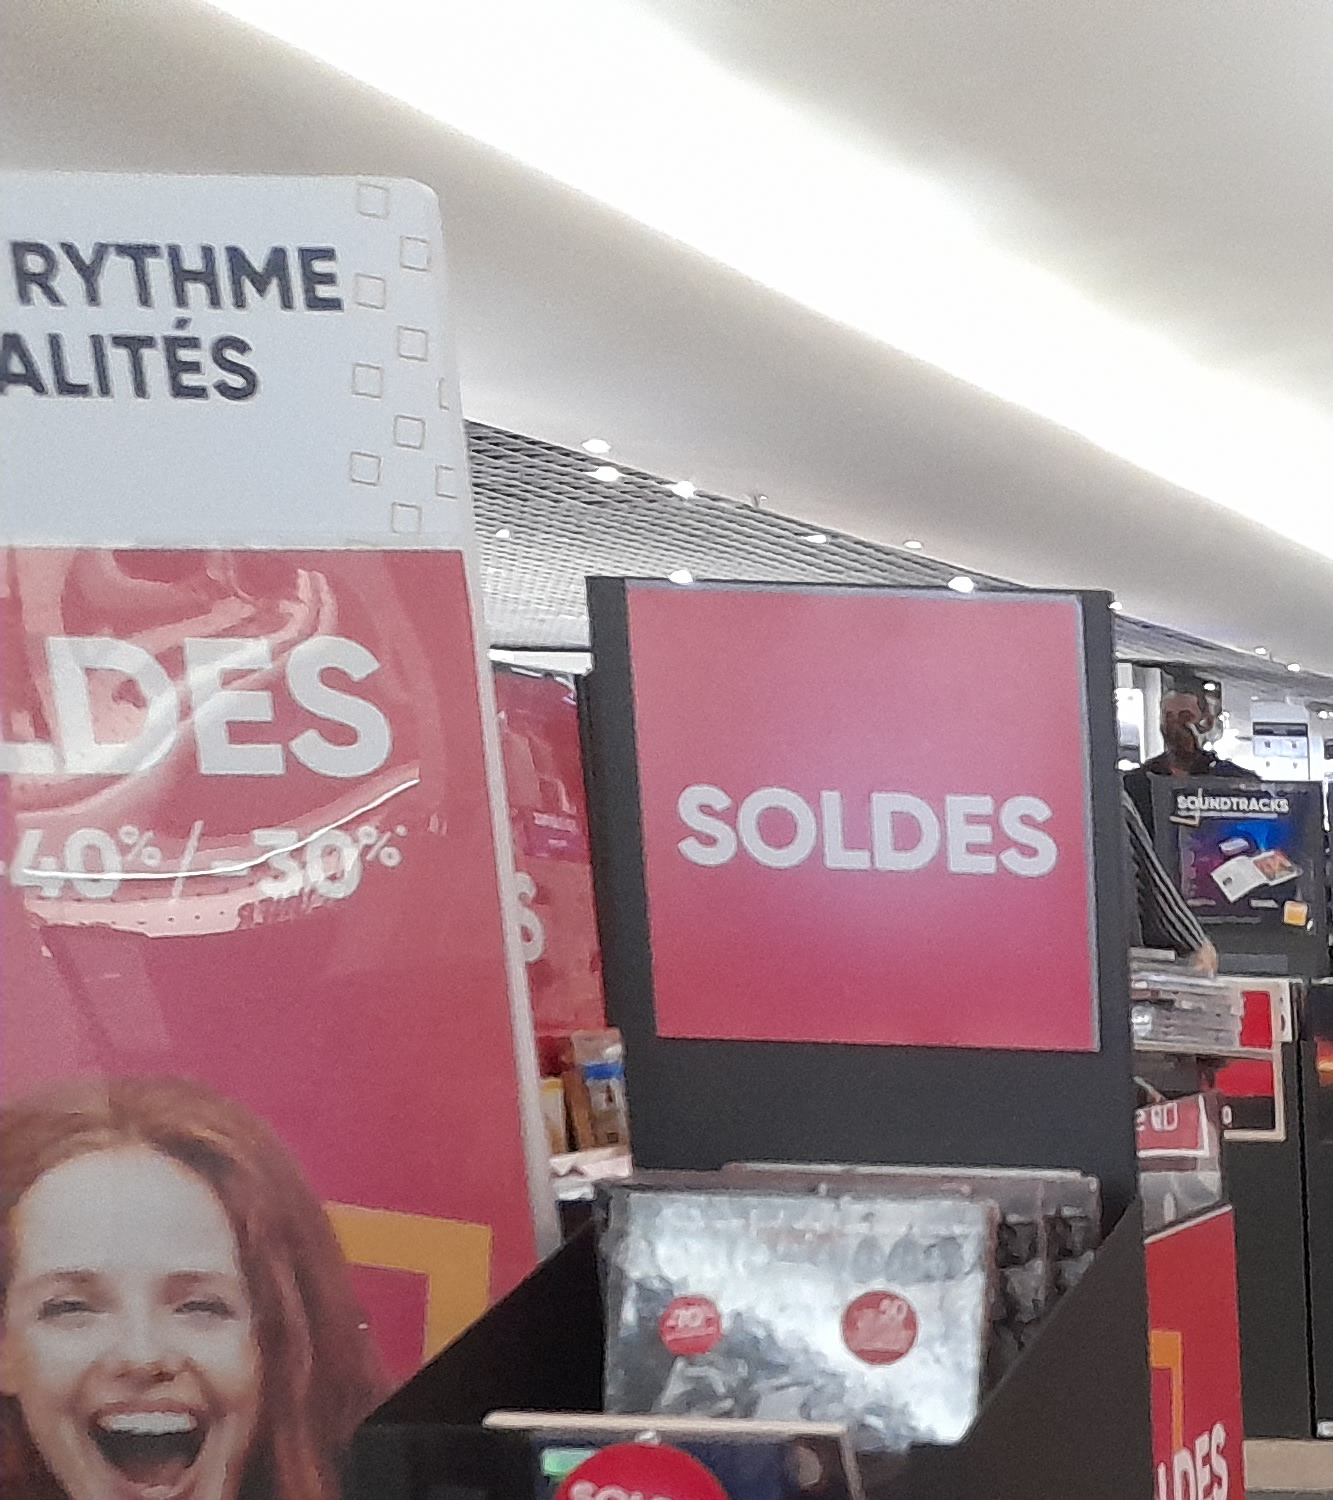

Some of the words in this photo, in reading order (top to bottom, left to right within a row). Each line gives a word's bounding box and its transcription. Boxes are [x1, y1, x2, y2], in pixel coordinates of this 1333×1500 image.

[9, 241, 345, 312] RYTHME
[0, 317, 258, 401] ALITÉS
[677, 784, 1059, 878] SOLDES
[1177, 795, 1289, 813] SOUNDTRACKS
